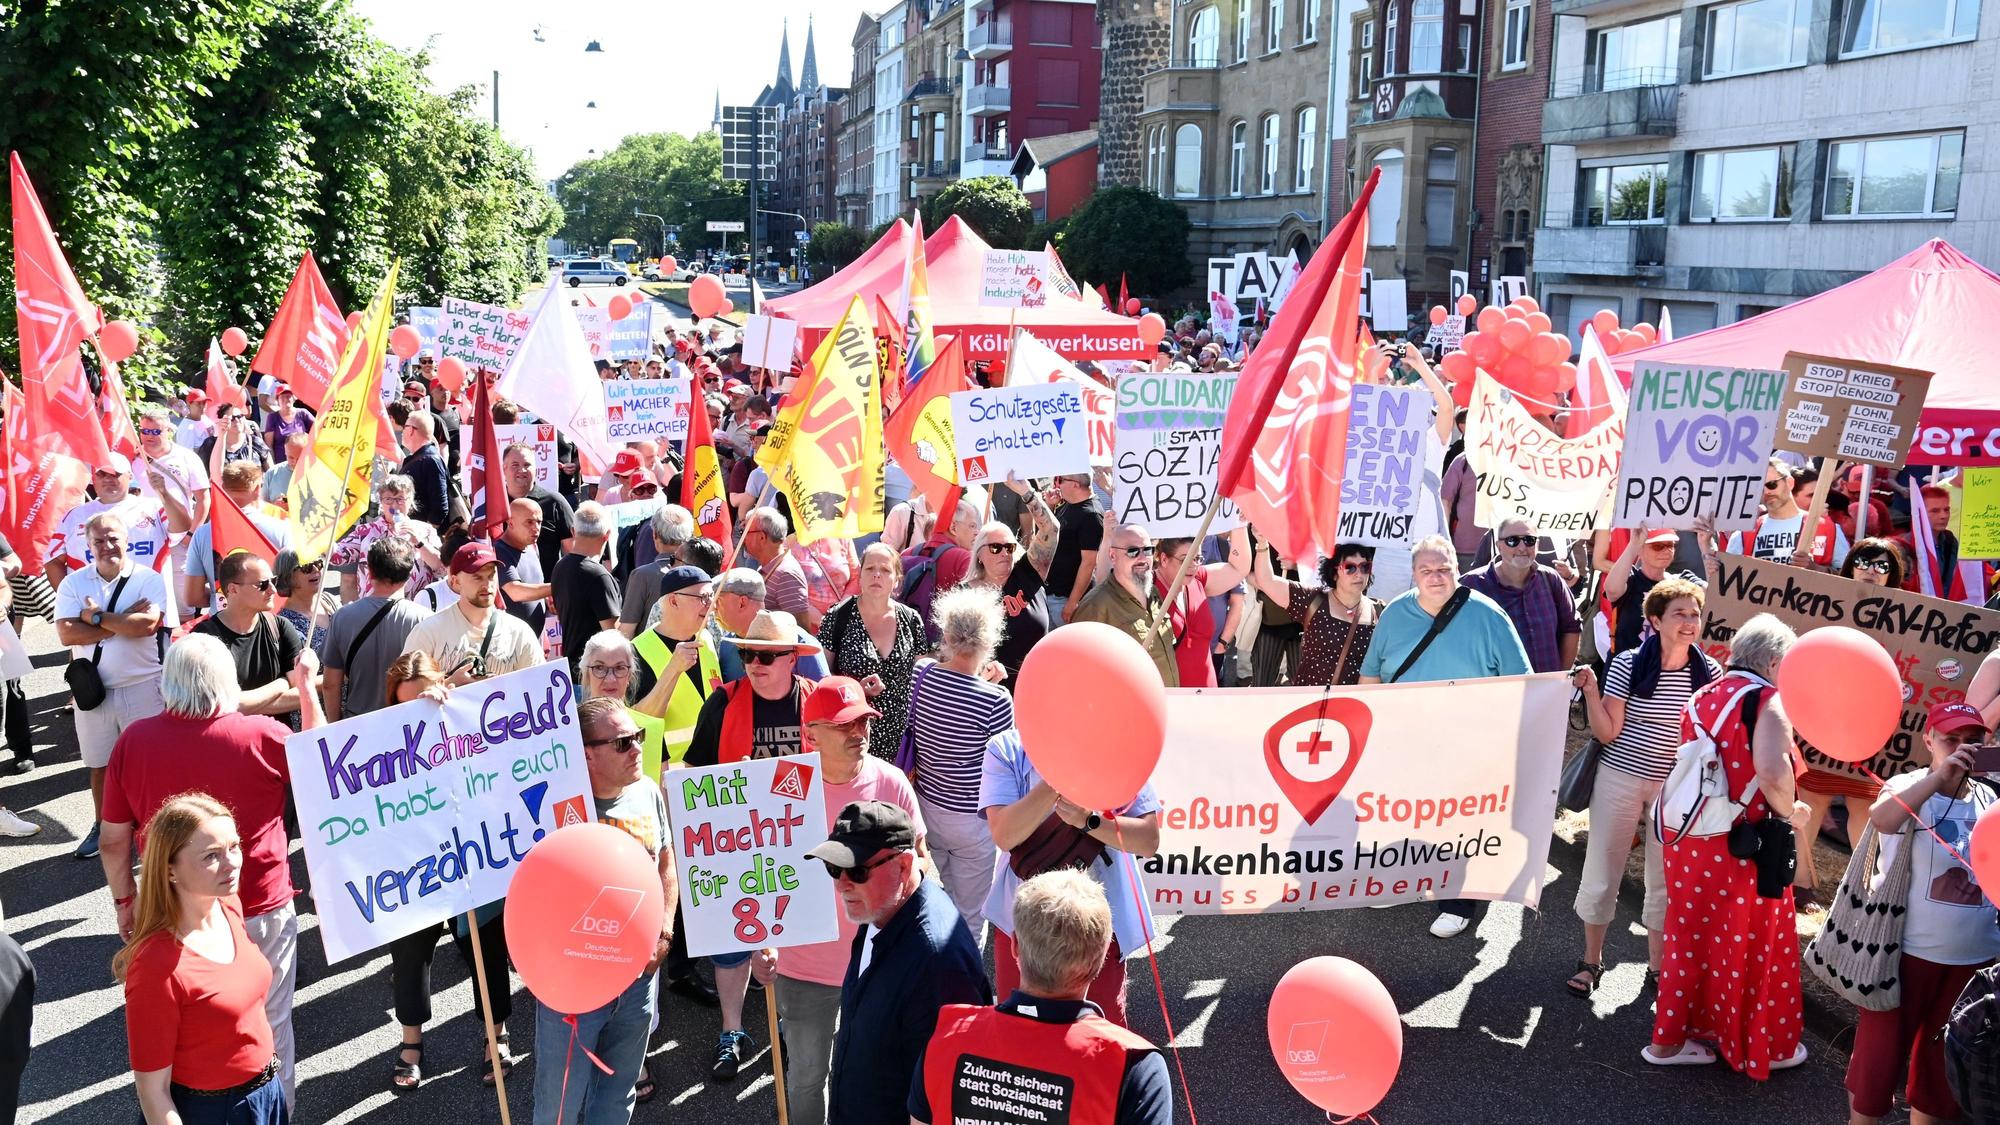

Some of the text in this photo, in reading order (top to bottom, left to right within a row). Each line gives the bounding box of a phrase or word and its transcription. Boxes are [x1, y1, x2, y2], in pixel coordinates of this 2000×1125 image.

[447, 300, 480, 318] Lieber
[452, 318, 464, 329] in
[469, 322, 488, 336] der
[438, 329, 454, 345] als
[458, 334, 474, 347] die
[476, 336, 505, 355] Rente
[1810, 366, 1844, 378] STOP
[608, 384, 628, 398] Wir
[1120, 377, 1238, 409] SOLIDARIT
[1636, 369, 1786, 412] MENSCHEN
[1800, 381, 1833, 393] STOP
[624, 396, 672, 412] MACHER
[969, 391, 1081, 426] Schutzgesetz
[1803, 404, 1820, 412] WIR
[1854, 407, 1889, 421] LOHN,
[609, 420, 688, 437] GESCHACHER
[1788, 412, 1824, 424] ZAHLEN
[1790, 422, 1818, 432] NICHT
[1850, 421, 1896, 437] PFLEGE,
[975, 418, 1066, 452] erhalten!
[1170, 428, 1222, 445] STATT
[1655, 414, 1760, 468] VOR
[1791, 433, 1808, 441] MIT:
[1846, 433, 1887, 448] RENTE,
[1843, 445, 1895, 461] BILDUNG
[1624, 475, 1762, 519] PROFITE
[1718, 560, 1844, 621] Warkens
[428, 721, 488, 767] ohne
[480, 669, 572, 745] Geld?
[318, 737, 569, 846] Da habt ihr euch
[682, 769, 748, 811] Mit
[1159, 785, 1509, 834] ießung Stoppen!
[683, 803, 804, 858] Macht
[345, 780, 549, 924] verzählt!
[1354, 829, 1502, 870] Holweide
[688, 853, 800, 908] für die
[1155, 870, 1449, 905] muss bleiben!
[582, 916, 620, 934] DGB
[732, 895, 790, 944] 8!
[1288, 1050, 1316, 1062] DGB
[963, 1061, 1064, 1096] Zukunft sichern
[960, 1078, 1063, 1111] statt Sozialstaat
[971, 1095, 1048, 1121] schwächen.
